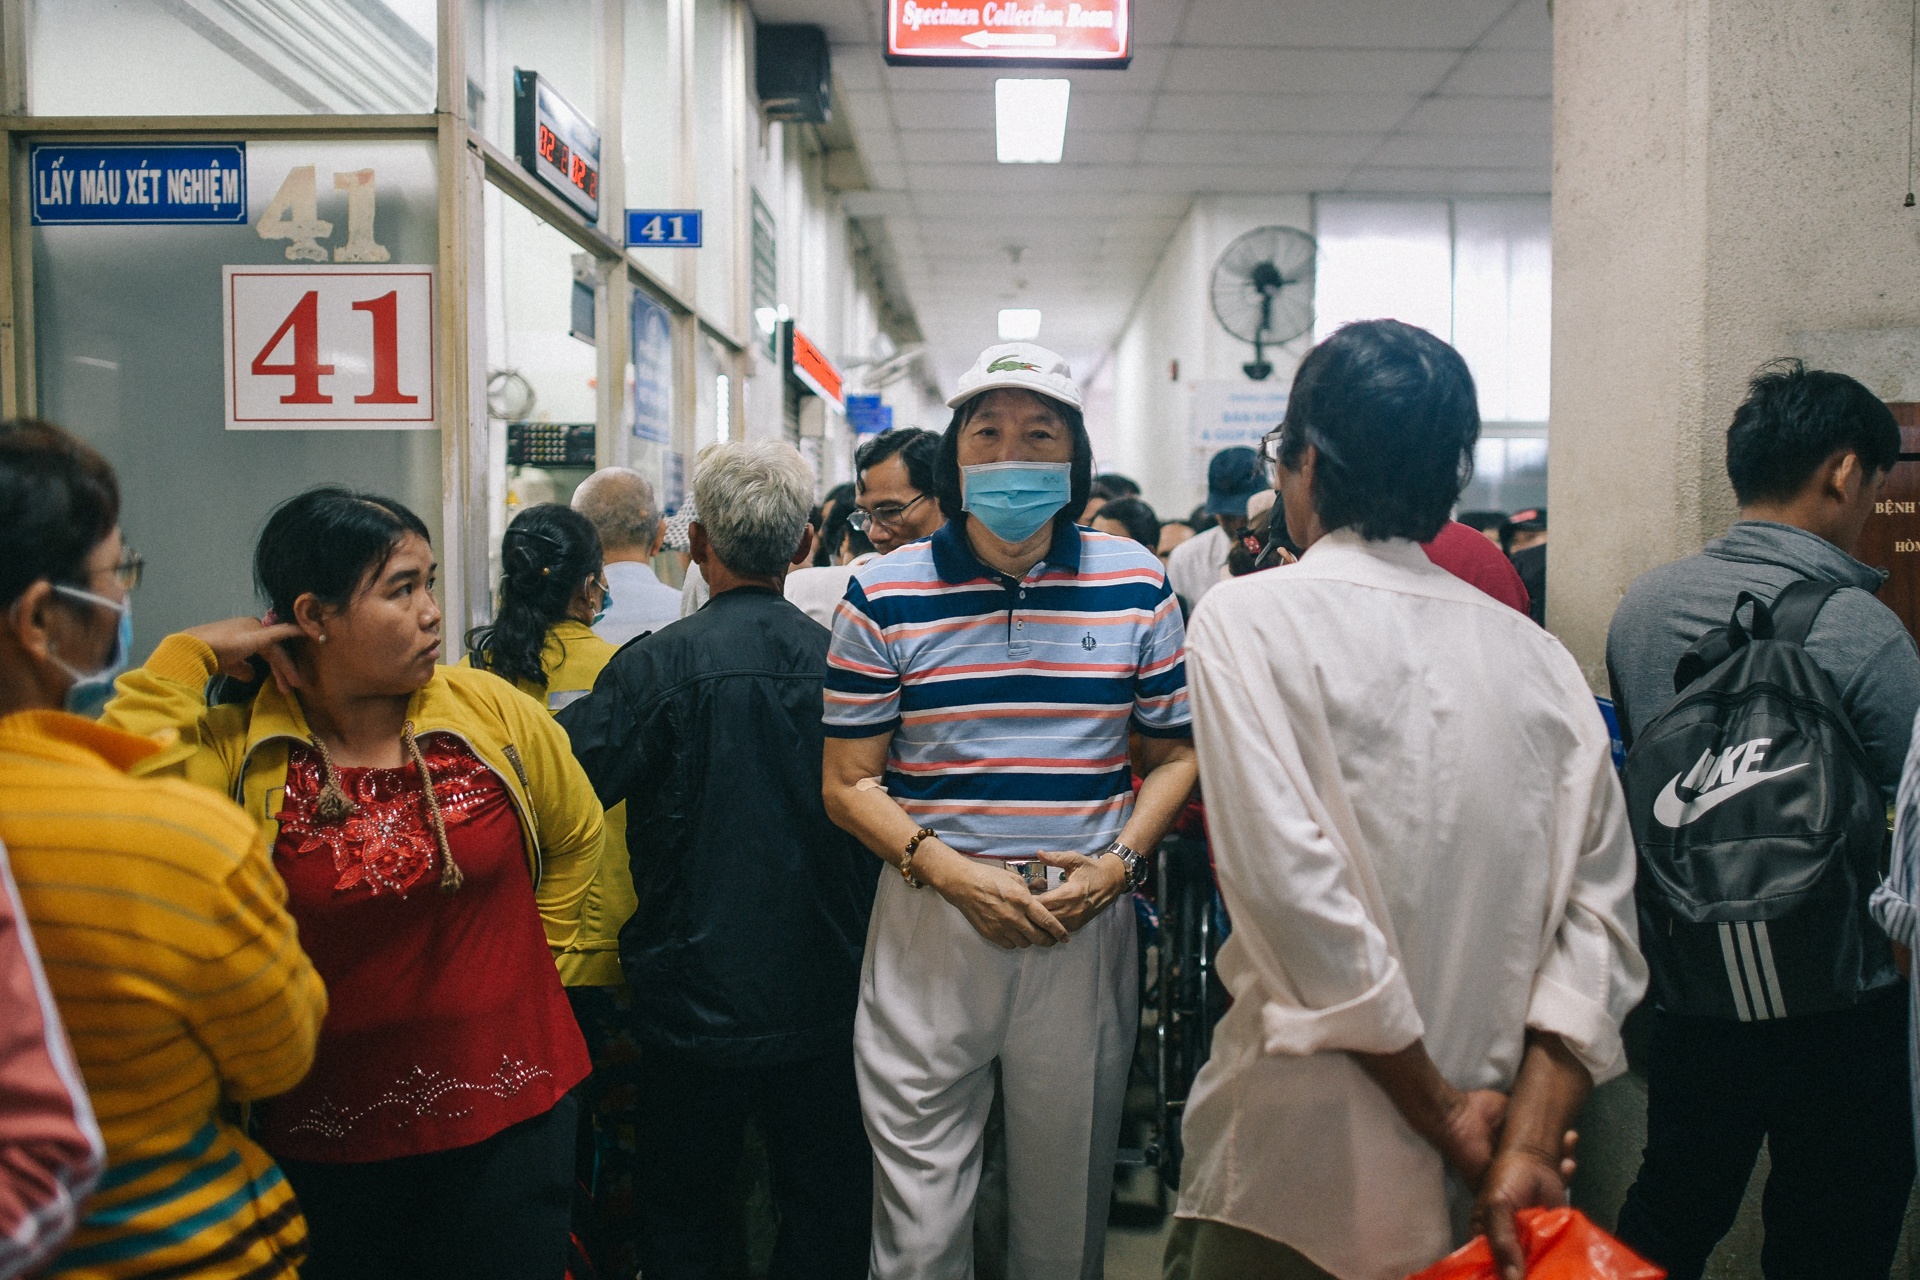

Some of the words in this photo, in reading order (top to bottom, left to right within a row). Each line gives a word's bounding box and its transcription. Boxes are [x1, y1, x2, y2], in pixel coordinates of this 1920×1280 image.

[903, 0, 979, 31] Specimen
[983, 2, 1064, 27] Collection
[1066, 3, 1113, 28] Room
[39, 156, 74, 205] LẤY
[80, 160, 121, 205] MÁU
[126, 160, 161, 205] XÉT
[167, 159, 239, 211] NGHIỆM
[256, 165, 391, 262] 41
[641, 216, 687, 241] 41
[252, 290, 418, 404] 41
[1875, 499, 1915, 515] BỆNH
